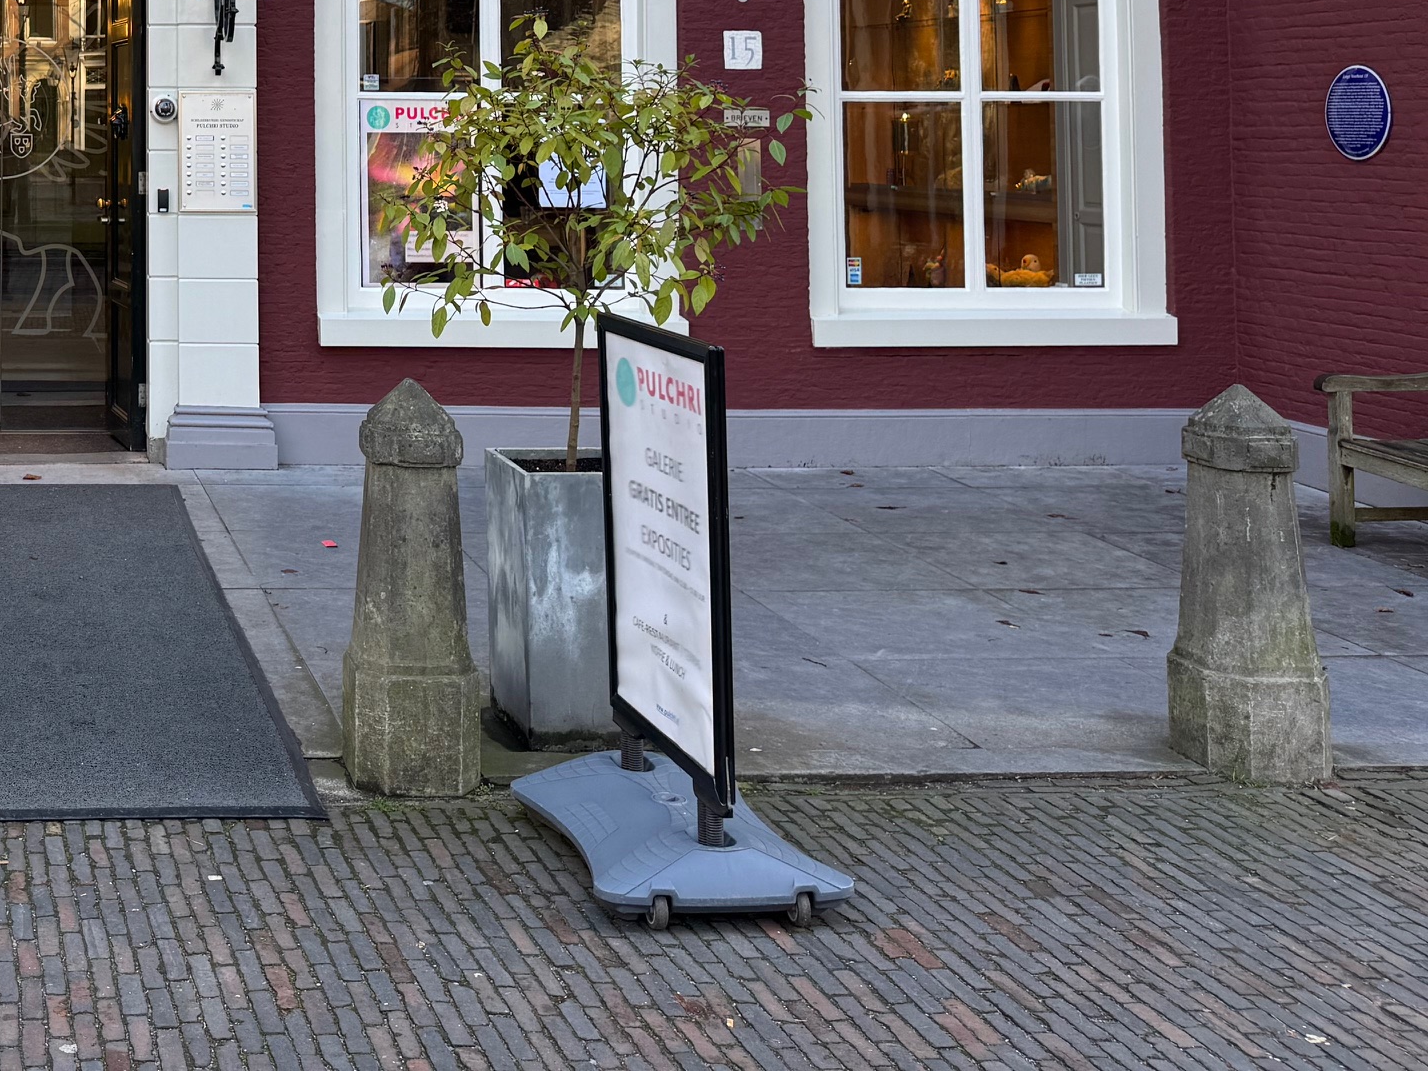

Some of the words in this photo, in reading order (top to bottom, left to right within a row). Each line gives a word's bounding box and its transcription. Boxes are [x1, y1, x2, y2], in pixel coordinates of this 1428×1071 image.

[730, 35, 757, 67] 15
[636, 366, 702, 416] PULCHRI
[645, 447, 684, 483] GALERIE
[628, 480, 664, 513] GRATIS
[665, 497, 700, 535] ENTREE
[640, 524, 691, 571] EXPOSITIES
[670, 658, 686, 680] LUNCH
